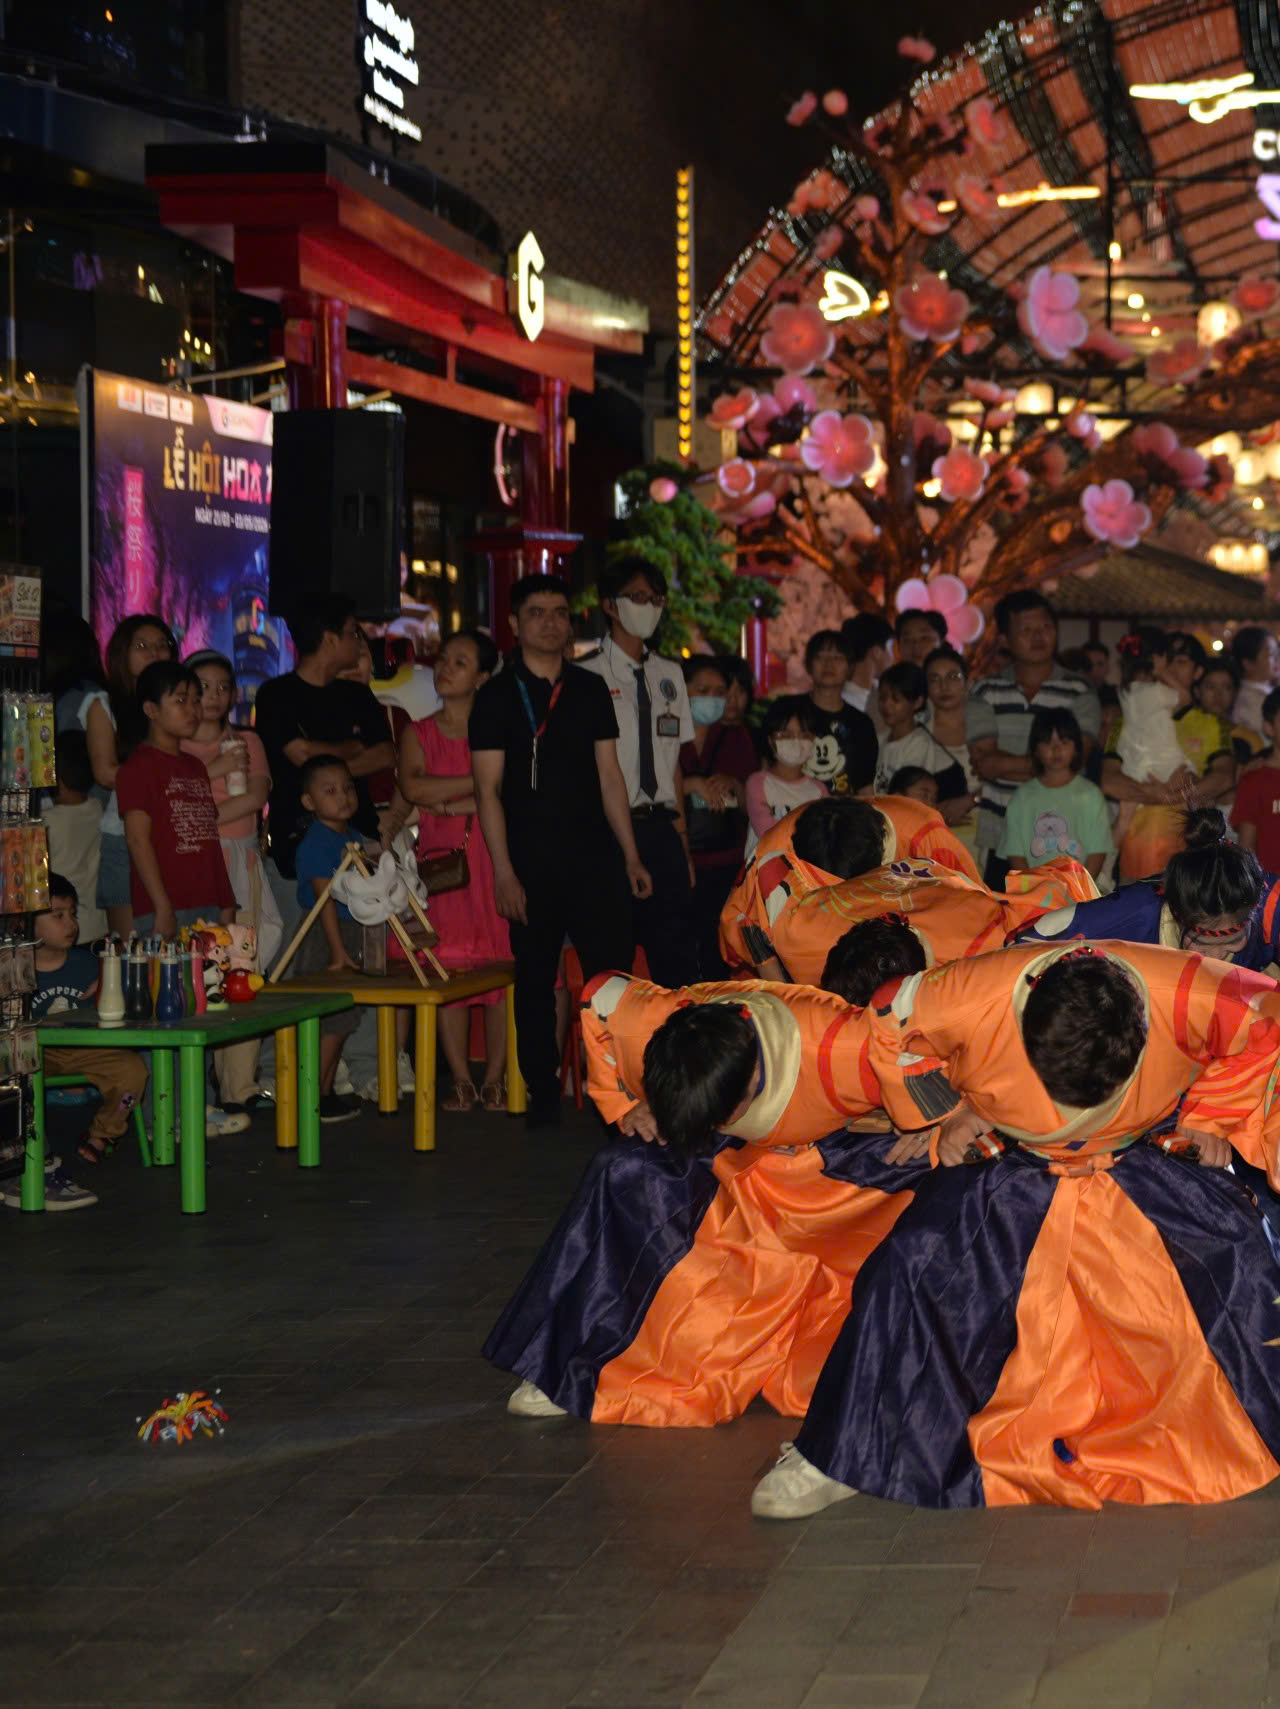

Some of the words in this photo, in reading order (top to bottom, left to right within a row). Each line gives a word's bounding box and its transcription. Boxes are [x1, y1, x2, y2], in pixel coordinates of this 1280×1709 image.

[518, 230, 545, 342] G
[163, 425, 185, 491] LỄ
[189, 439, 221, 505] HỘI
[223, 455, 262, 504] HOA
